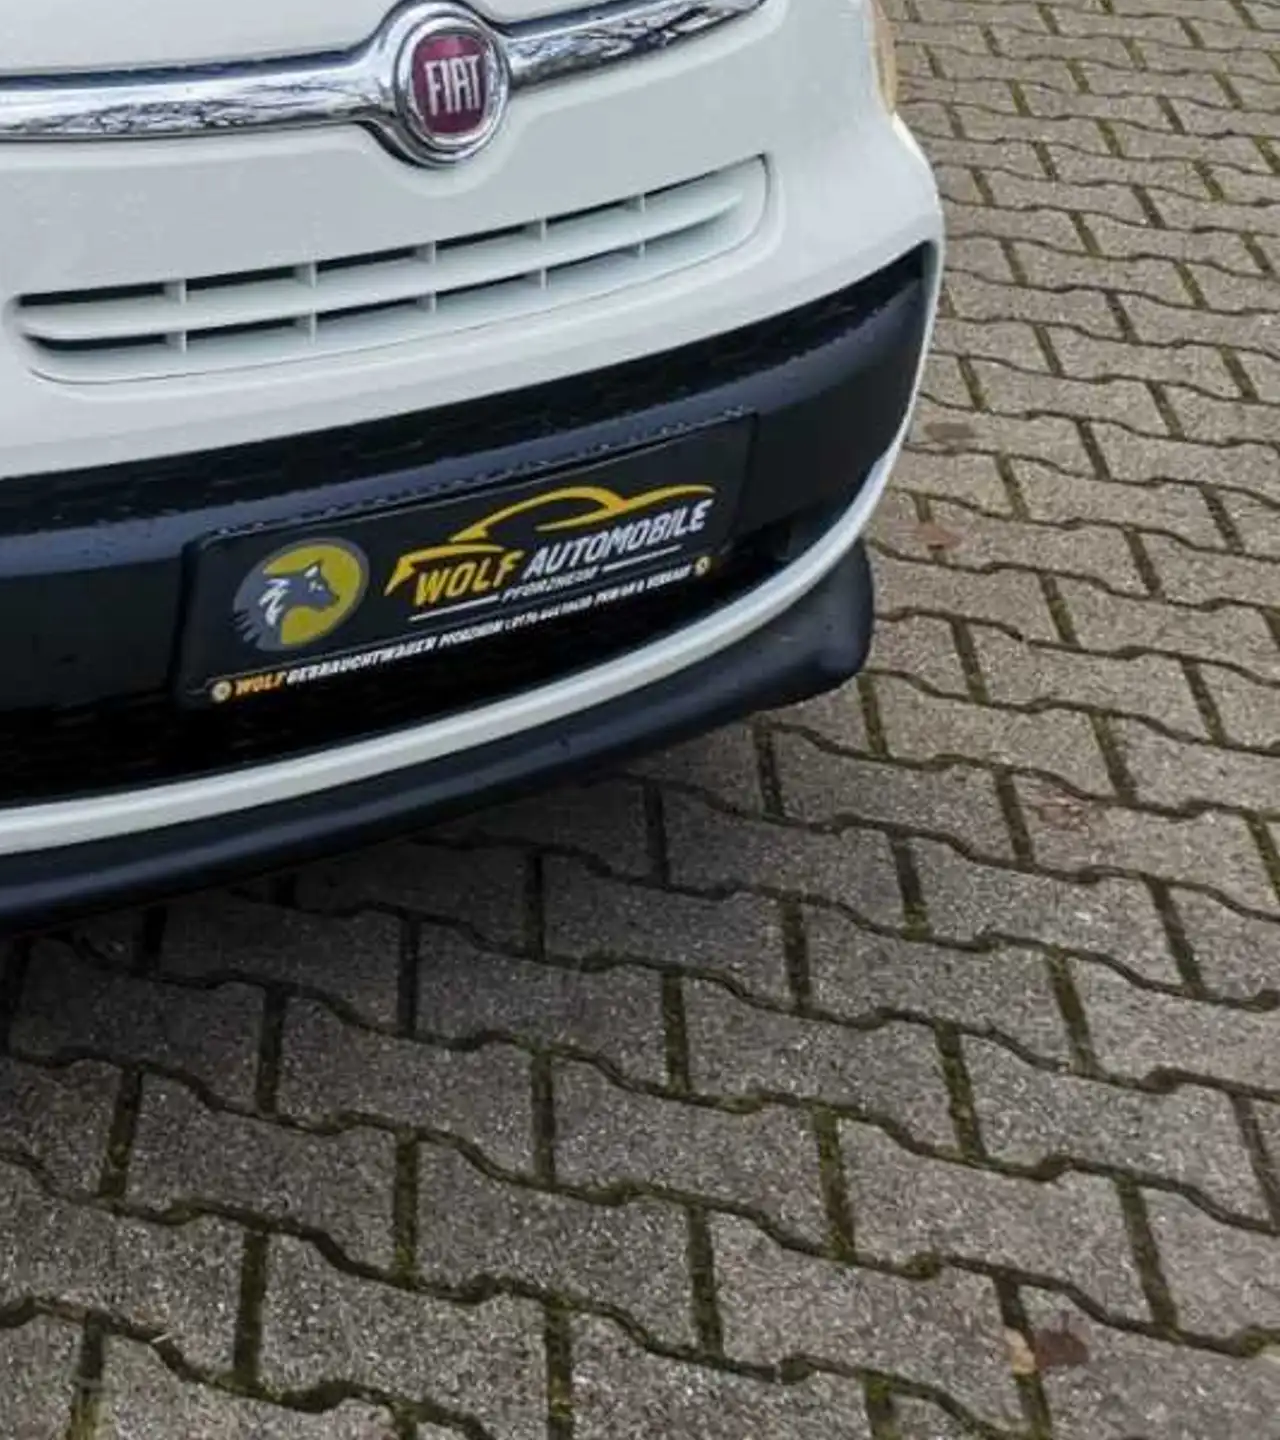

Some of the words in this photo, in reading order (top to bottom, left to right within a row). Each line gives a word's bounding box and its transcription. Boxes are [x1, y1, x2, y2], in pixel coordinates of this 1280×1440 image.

[424, 54, 480, 117] FIAT
[415, 549, 524, 607] WOLF
[521, 499, 714, 580] AUTOMOBILE
